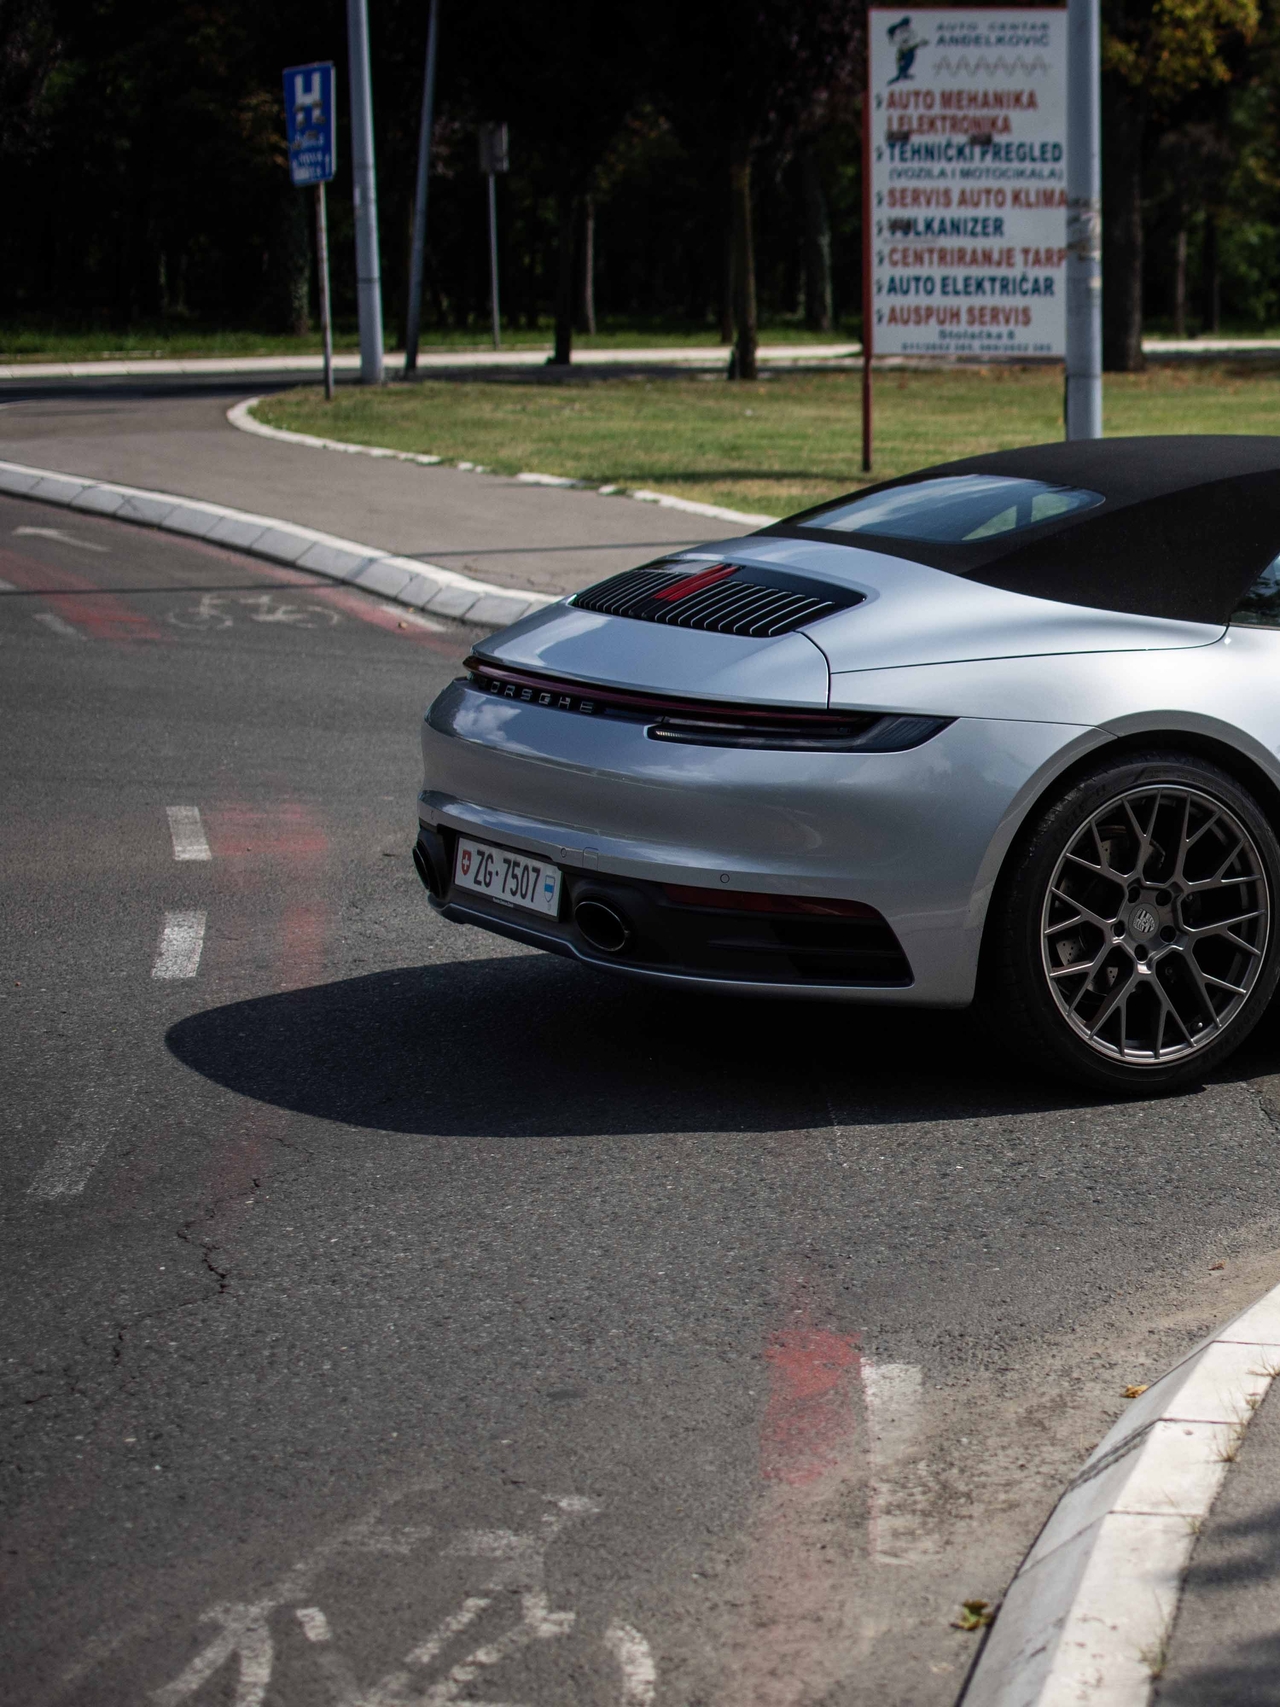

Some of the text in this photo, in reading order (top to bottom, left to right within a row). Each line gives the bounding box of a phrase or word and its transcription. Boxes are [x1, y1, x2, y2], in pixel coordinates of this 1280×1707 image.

[936, 22, 1049, 31] AUTO CENTAR
[886, 90, 1038, 110] AUTO MEHANIKA
[888, 138, 1063, 162] TEHNIČKI PREGLED
[887, 187, 1067, 208] SERVIS AUTO KLIMA
[887, 247, 1016, 268] CENTRIRANJE
[886, 271, 1055, 296] AUTO ELEKTRIČAR
[887, 305, 1032, 326] AUSPUH SERVIS
